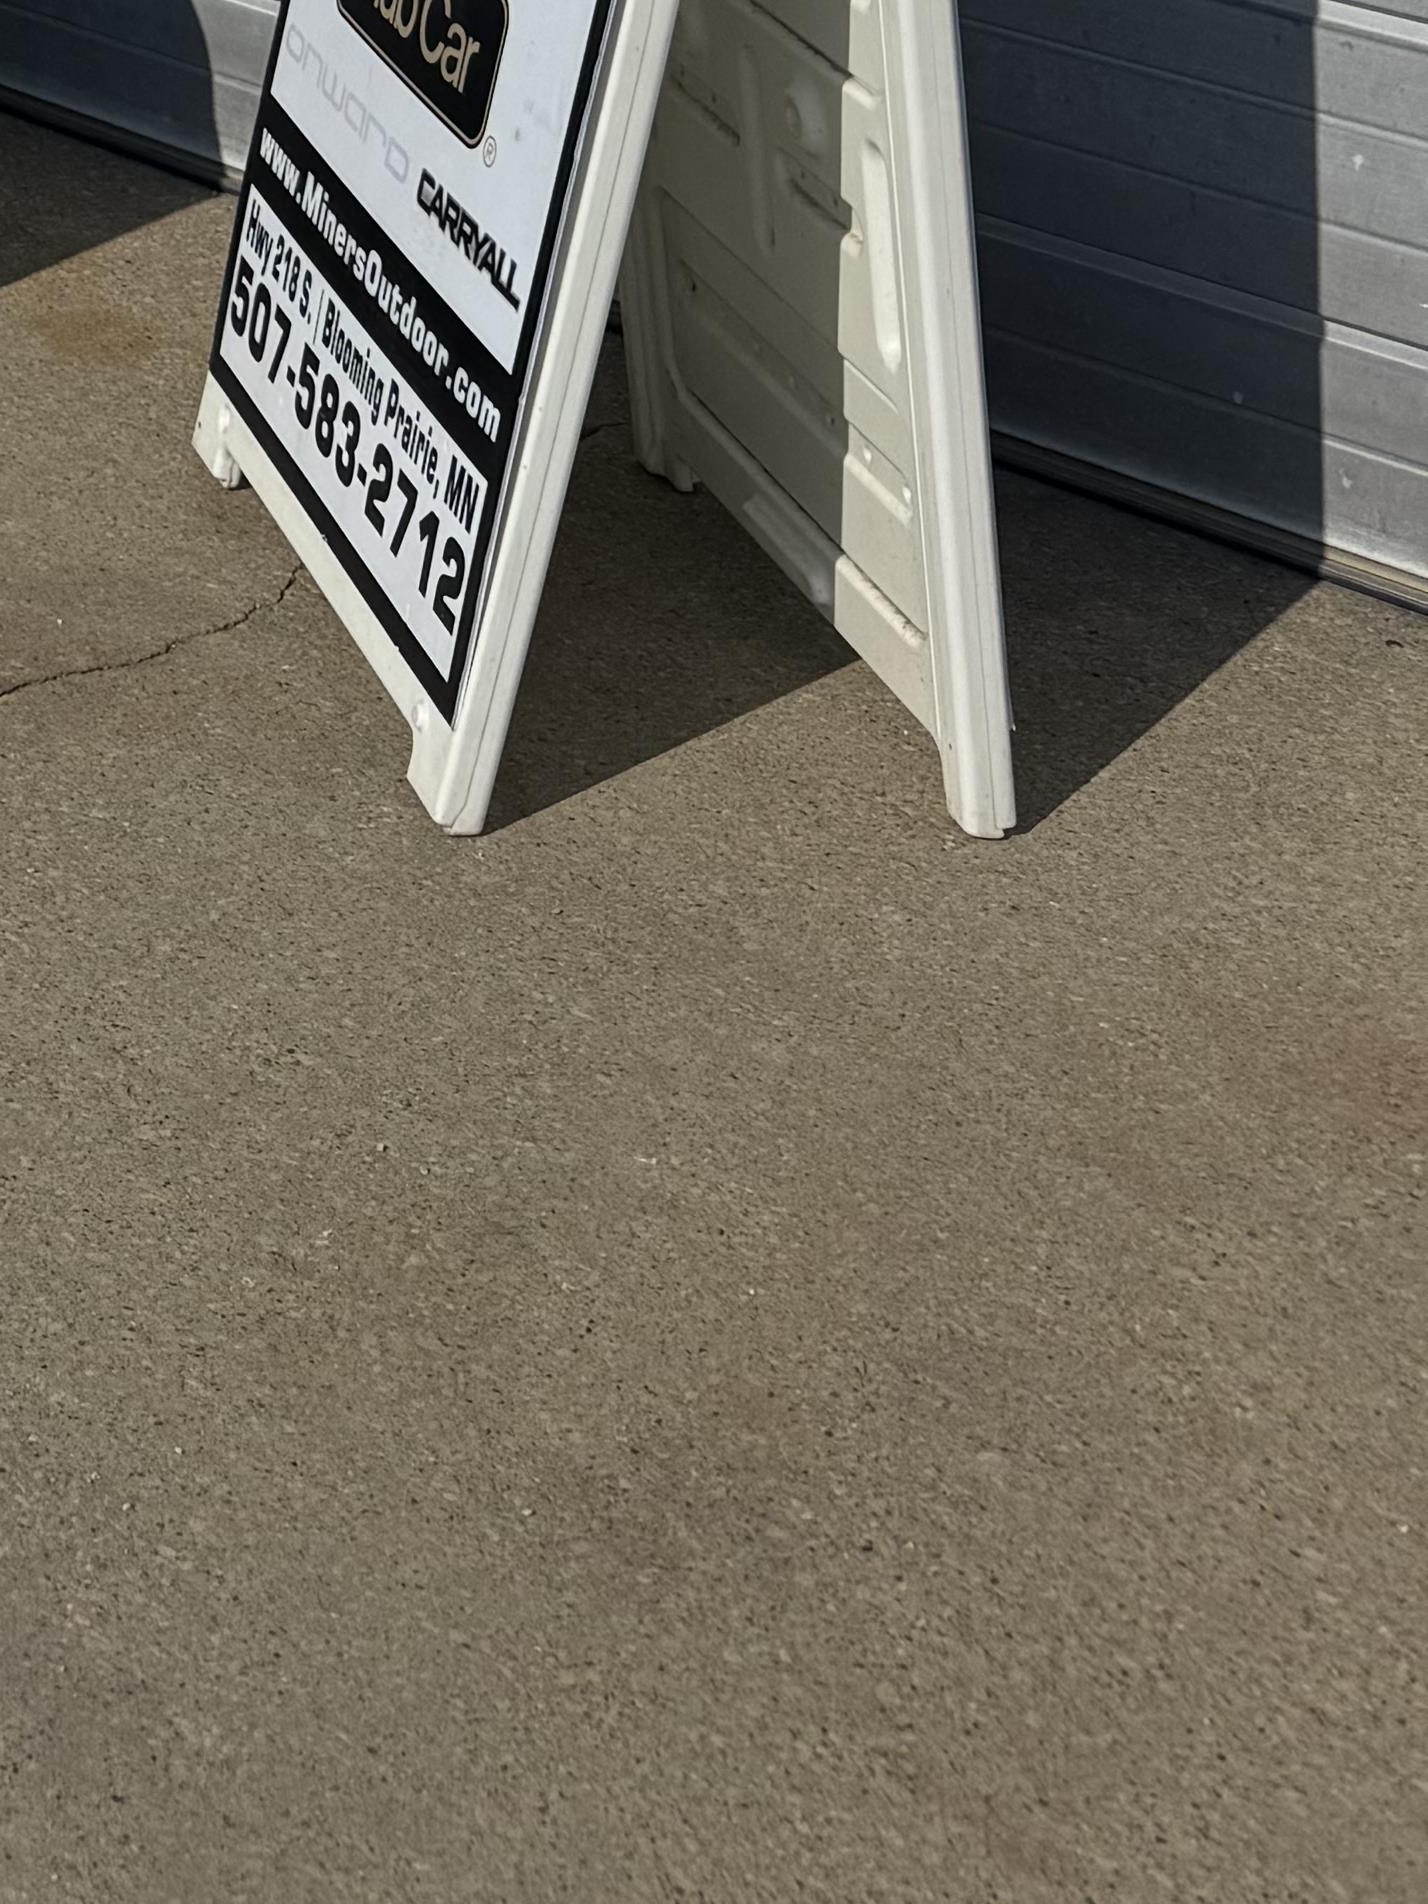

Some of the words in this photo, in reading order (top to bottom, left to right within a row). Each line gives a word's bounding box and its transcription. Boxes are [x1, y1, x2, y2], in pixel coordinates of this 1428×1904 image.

[246, 199, 274, 276] Hwy
[271, 234, 301, 302] 218
[322, 297, 385, 426] Blooming
[384, 378, 440, 500] Prairie,
[443, 454, 480, 535] MN
[259, 127, 502, 443] www.MinersOutdoor.com
[415, 167, 521, 313] CARRYALL
[230, 254, 466, 637] 507-583-2712
